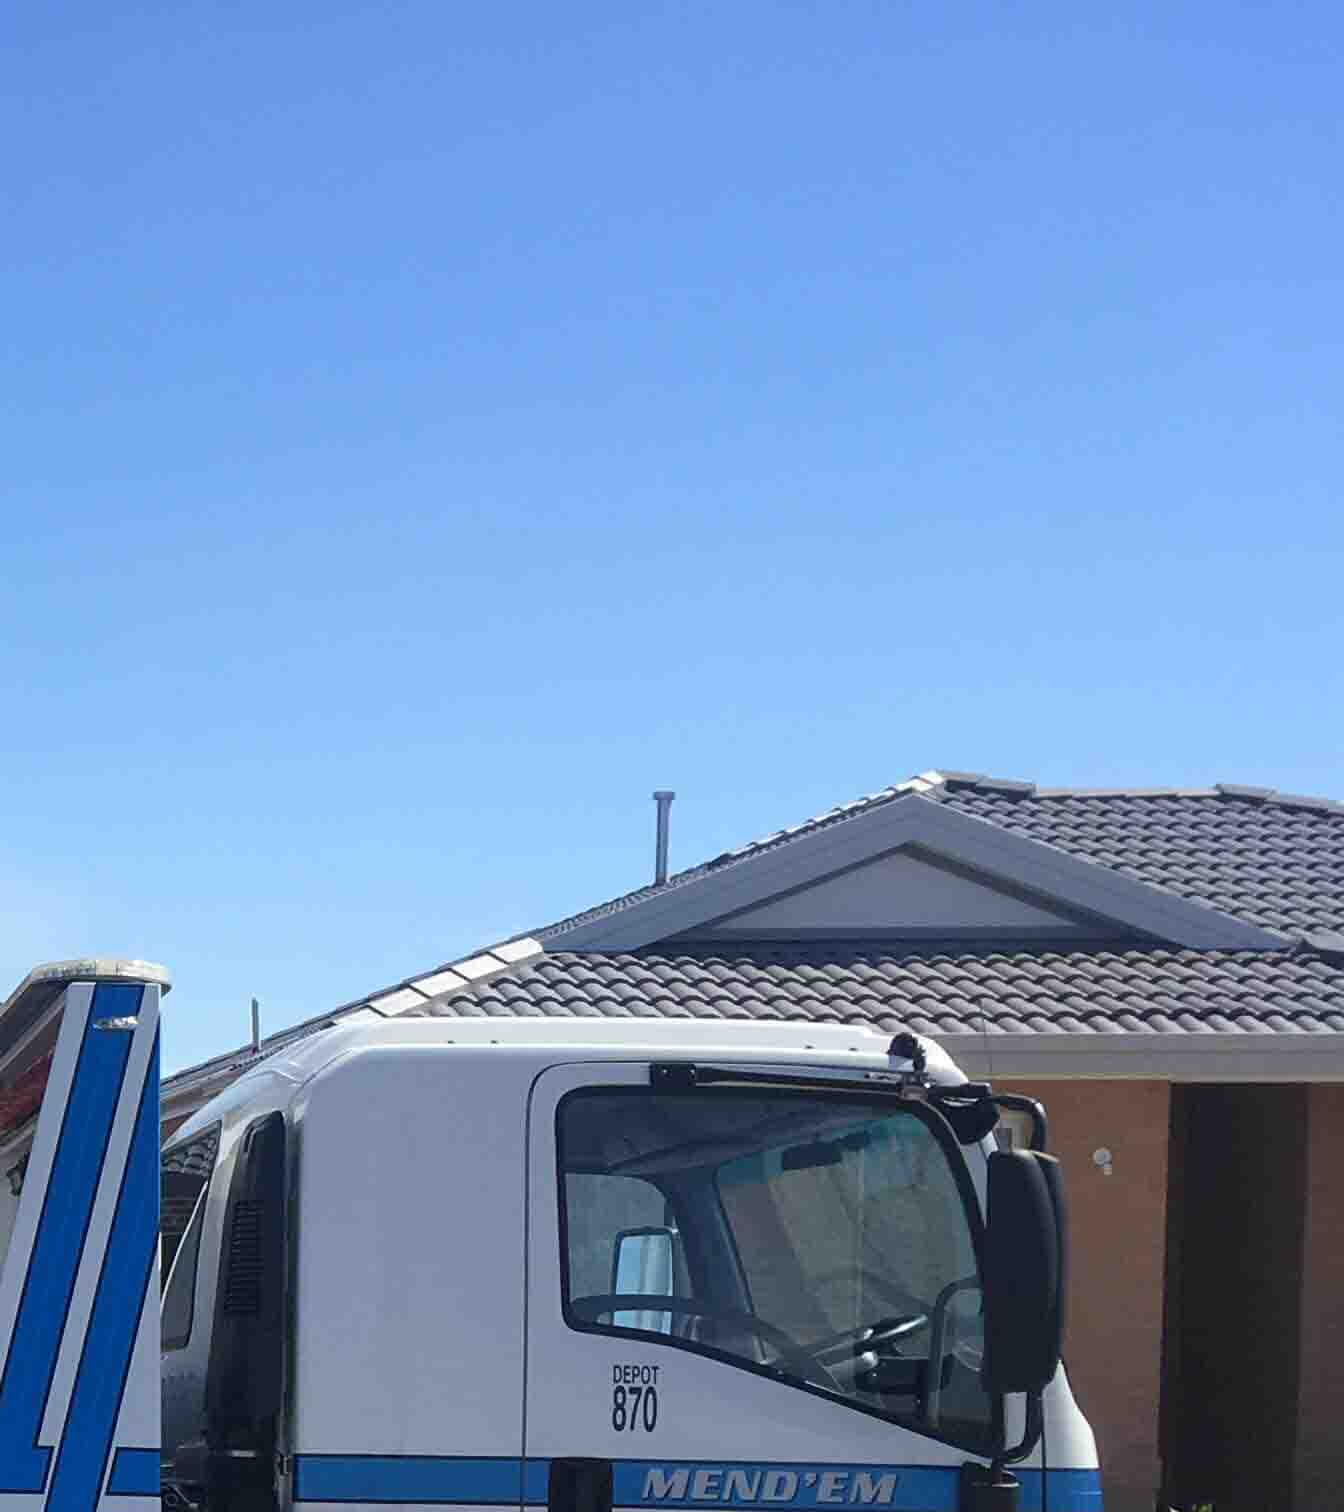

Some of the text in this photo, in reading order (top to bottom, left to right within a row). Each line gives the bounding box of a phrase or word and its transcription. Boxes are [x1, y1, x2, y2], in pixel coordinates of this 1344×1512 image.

[613, 1365, 659, 1385] DEPOT
[612, 1386, 657, 1433] 870
[642, 1469, 898, 1504] MEND'EM
